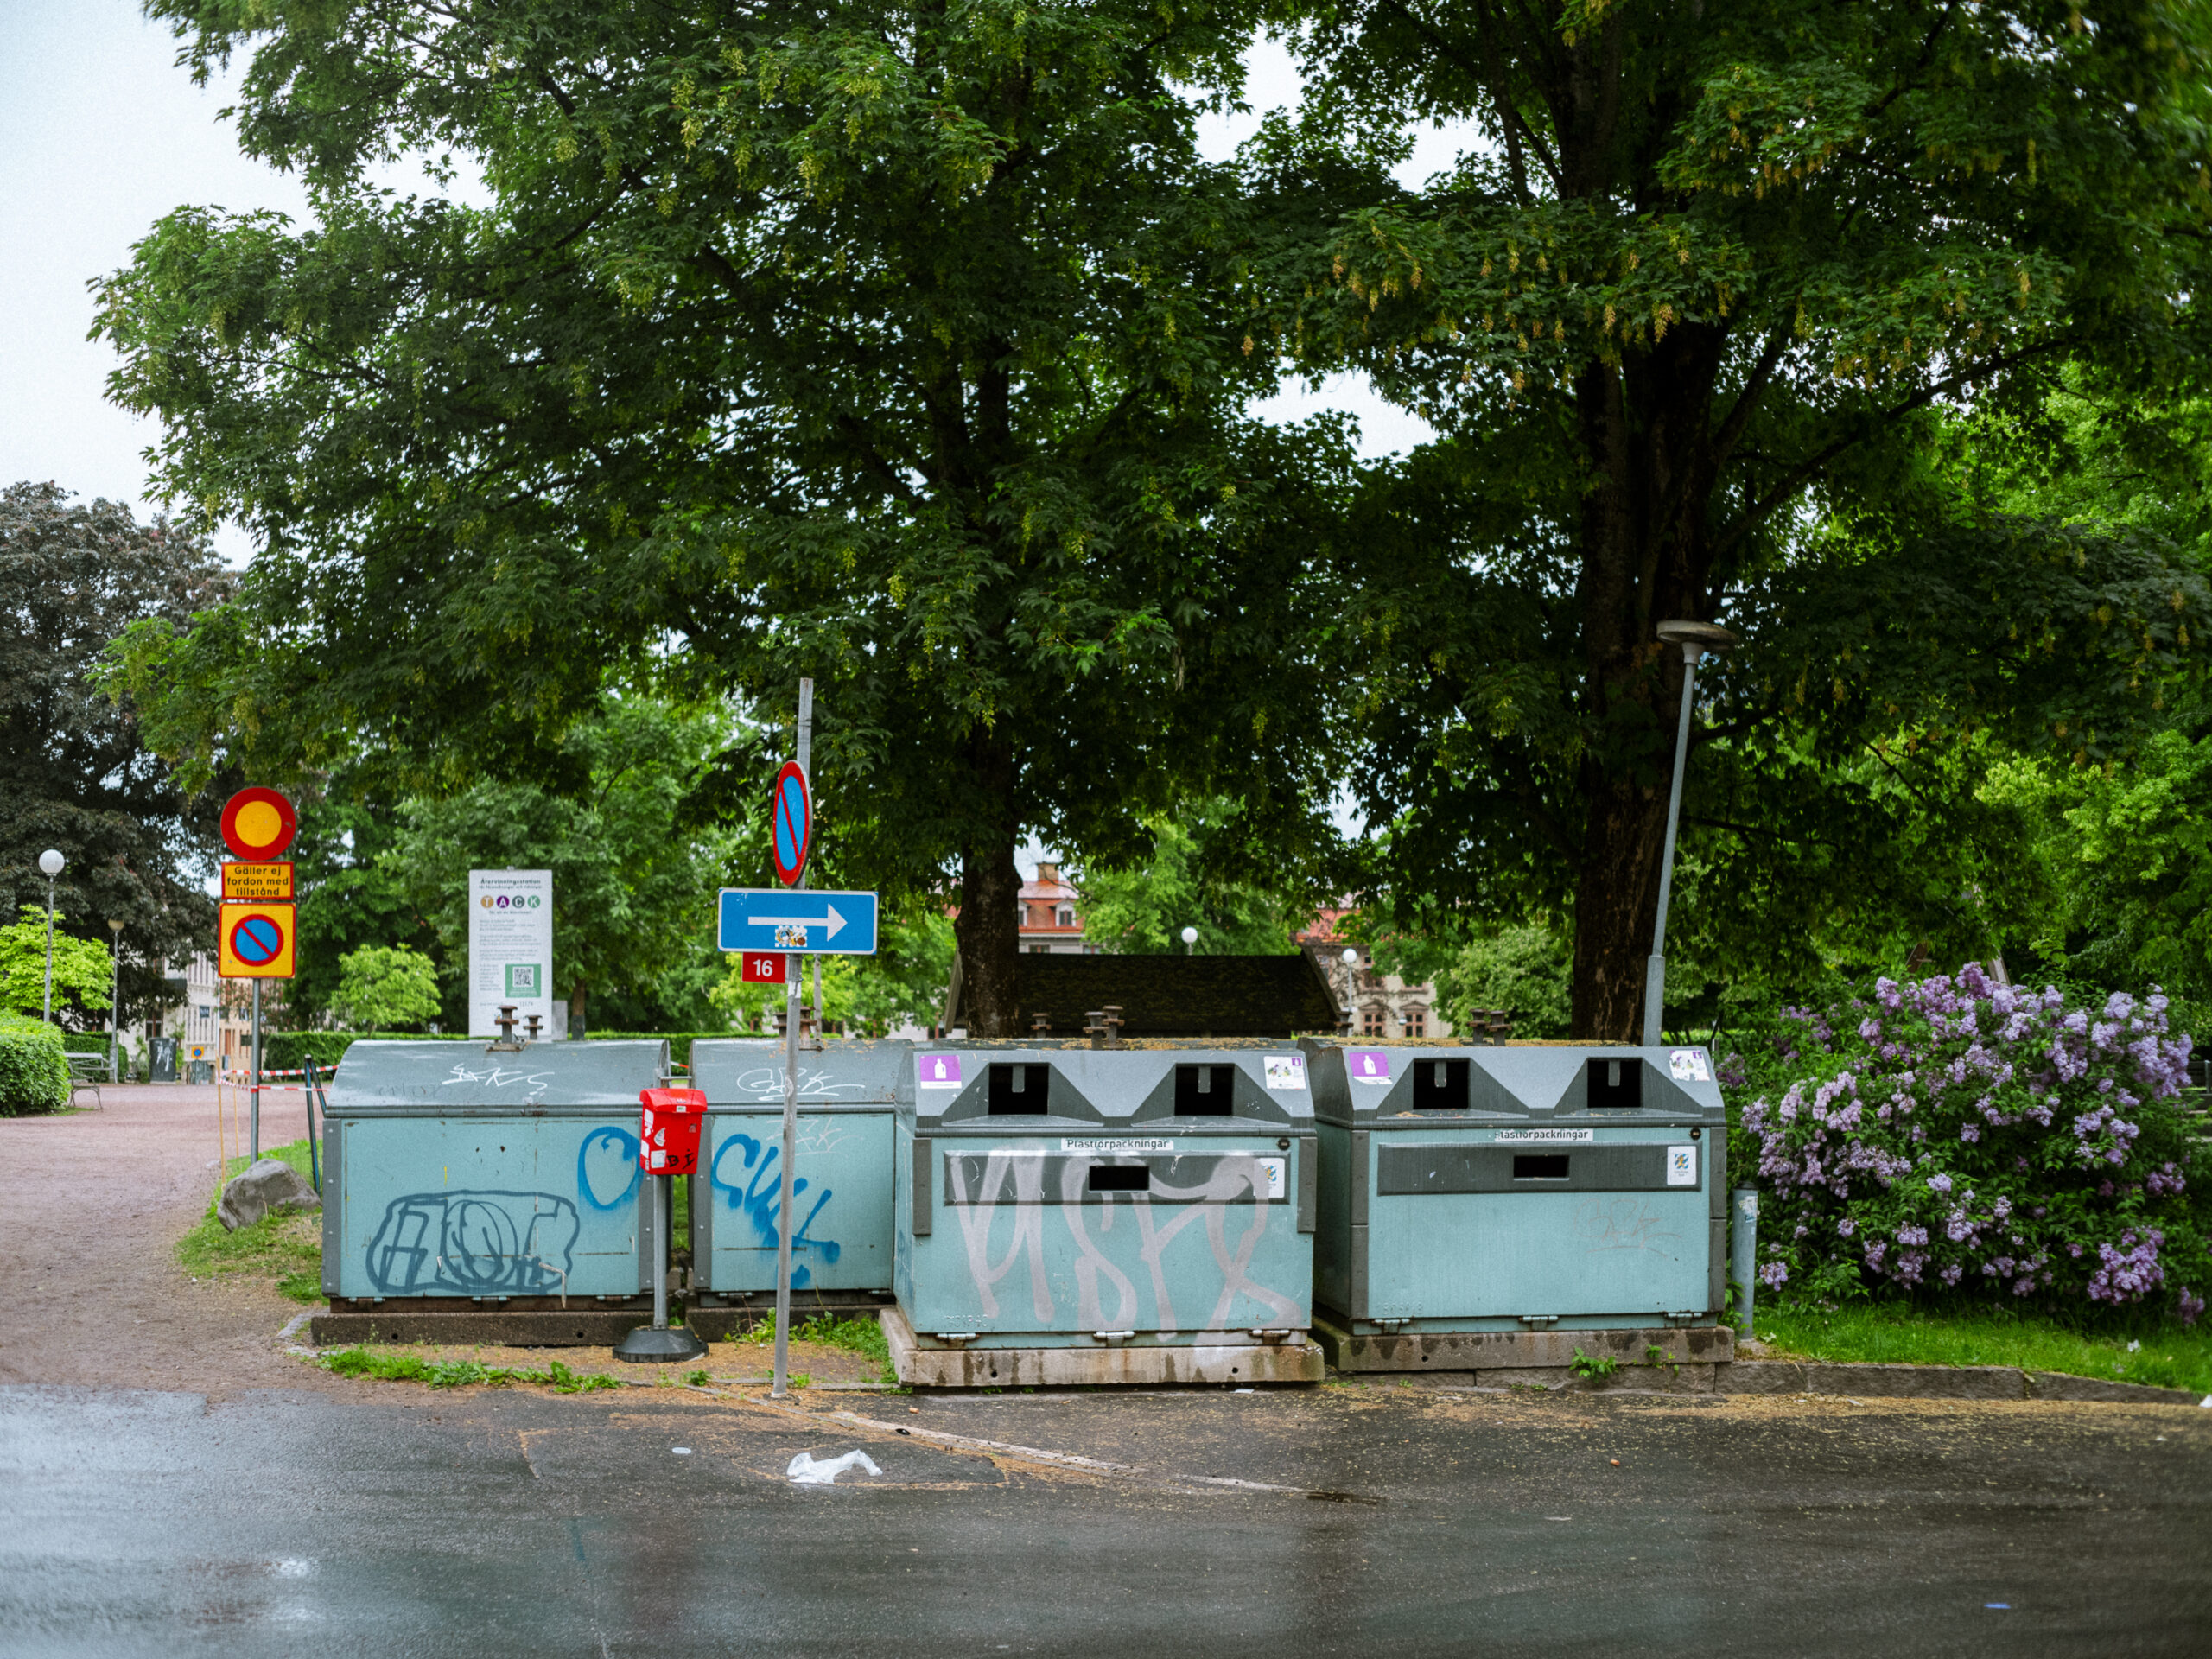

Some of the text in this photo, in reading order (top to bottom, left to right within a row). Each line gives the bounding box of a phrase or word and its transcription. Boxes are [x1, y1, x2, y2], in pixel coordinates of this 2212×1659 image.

[234, 866, 281, 876] Gäller ej
[227, 877, 289, 886] fordon med
[236, 887, 280, 896] tillstånd
[753, 959, 773, 977] 16
